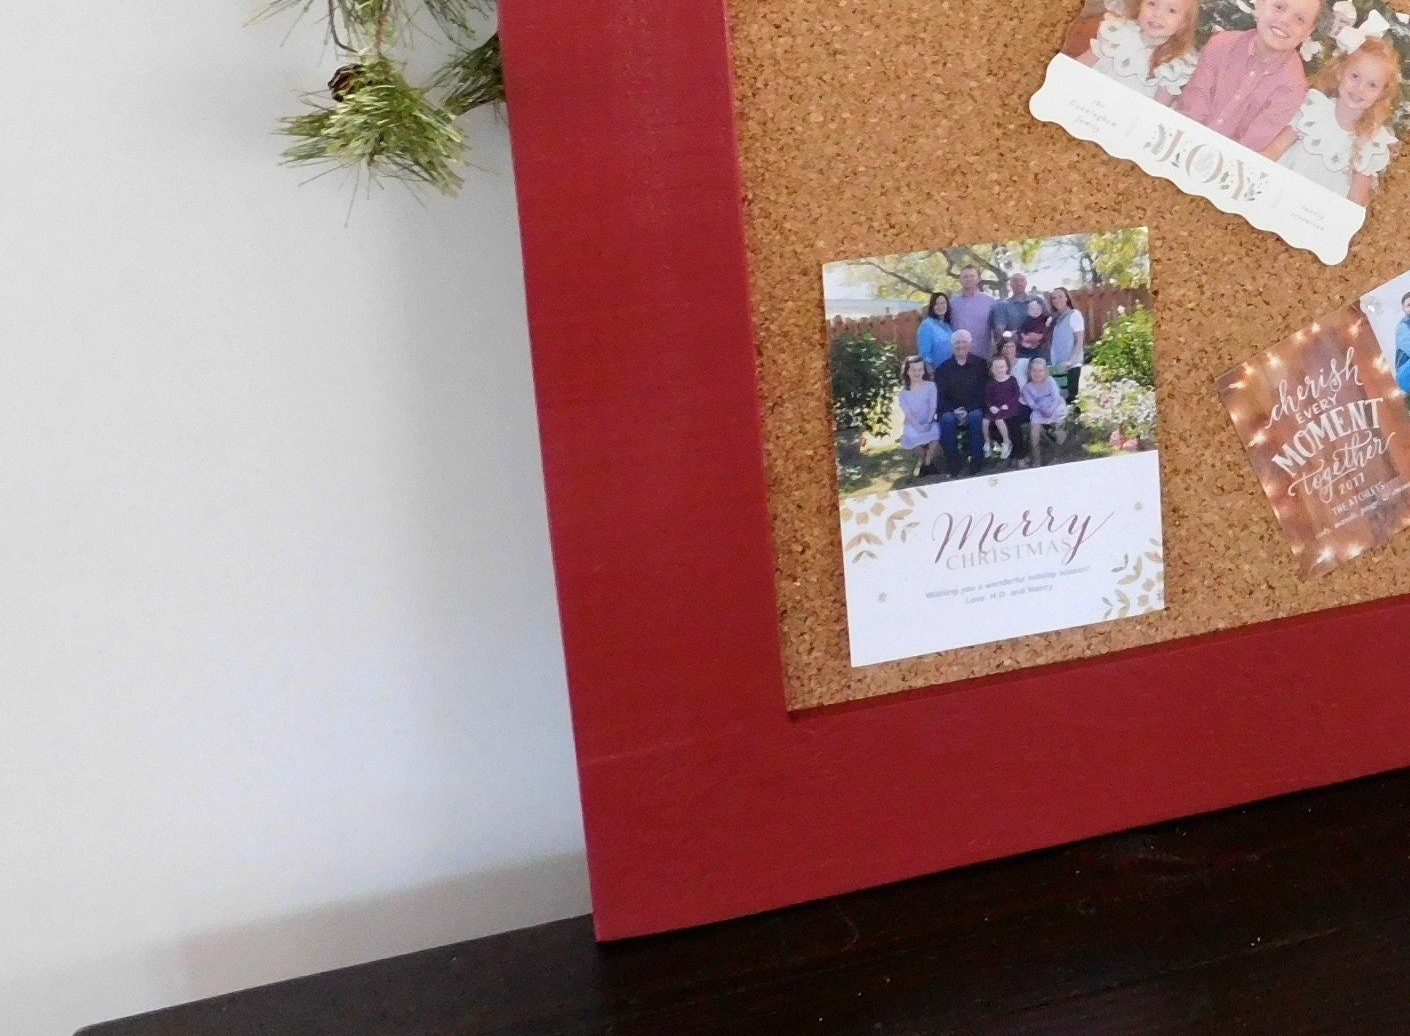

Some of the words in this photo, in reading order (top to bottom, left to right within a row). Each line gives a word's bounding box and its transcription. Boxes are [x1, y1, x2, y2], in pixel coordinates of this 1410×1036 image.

[1265, 346, 1364, 430] cherish
[1295, 393, 1339, 424] EVERY
[1271, 397, 1384, 478] MOMENT
[1287, 430, 1397, 504] together
[1338, 472, 1366, 495] 2017
[931, 505, 1116, 565] Merry
[946, 536, 1073, 571] CHRISTMAS
